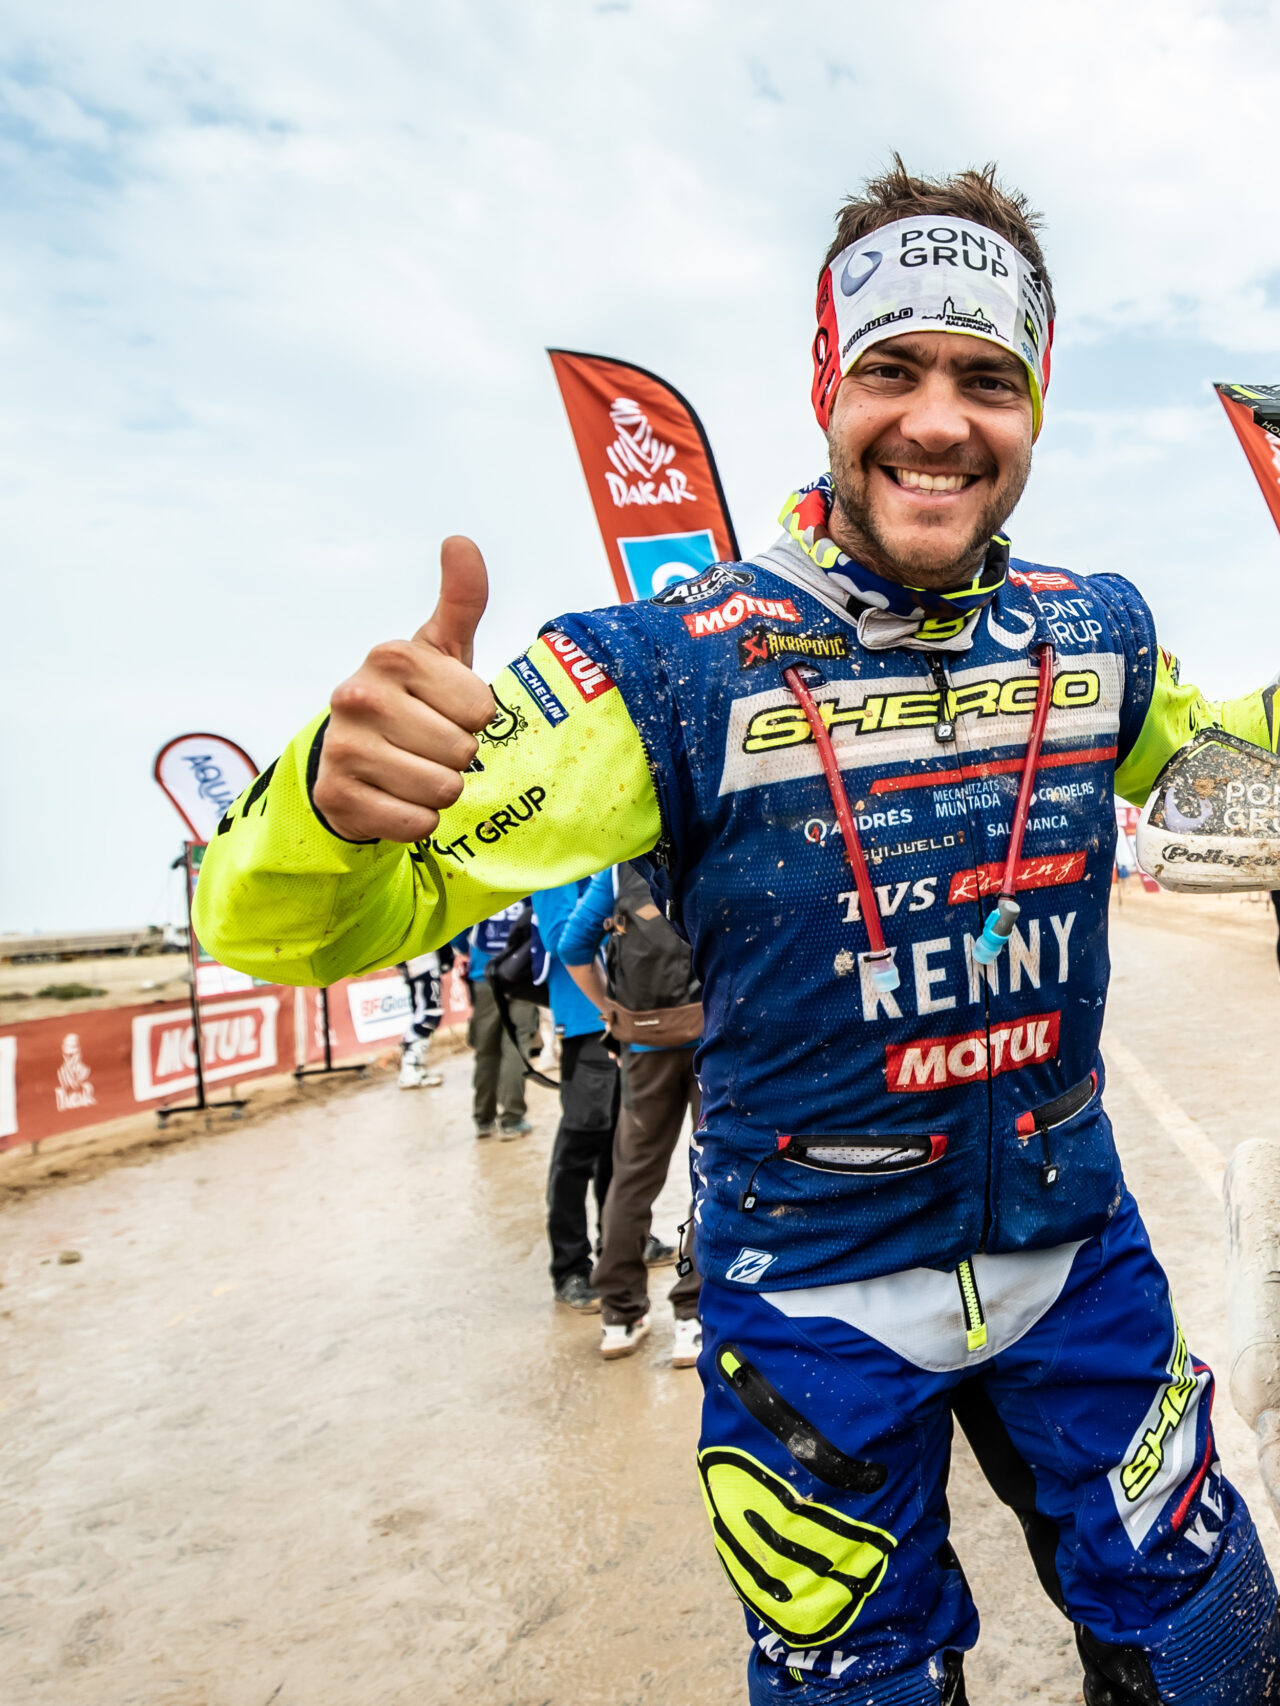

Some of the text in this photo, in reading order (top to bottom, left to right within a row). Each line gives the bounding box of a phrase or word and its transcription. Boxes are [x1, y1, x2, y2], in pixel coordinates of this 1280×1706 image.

[900, 247, 1009, 278] GRUP
[901, 227, 1006, 260] PONT
[604, 468, 698, 508] DAKAR
[695, 594, 796, 635] MOTUL
[1047, 619, 1103, 645] RUP
[741, 669, 1101, 755] SHERCO
[933, 779, 1000, 803] MECANITZATS
[934, 794, 1001, 818] MUNTADA
[475, 785, 547, 844] GRUP
[830, 808, 913, 836] ADRÉS
[986, 814, 1069, 837] SALMANCA
[837, 855, 1086, 924] TVS Raing
[857, 910, 1078, 1022] KENNY
[155, 1014, 259, 1078] MOTUL
[896, 1019, 1051, 1087] MOTUL
